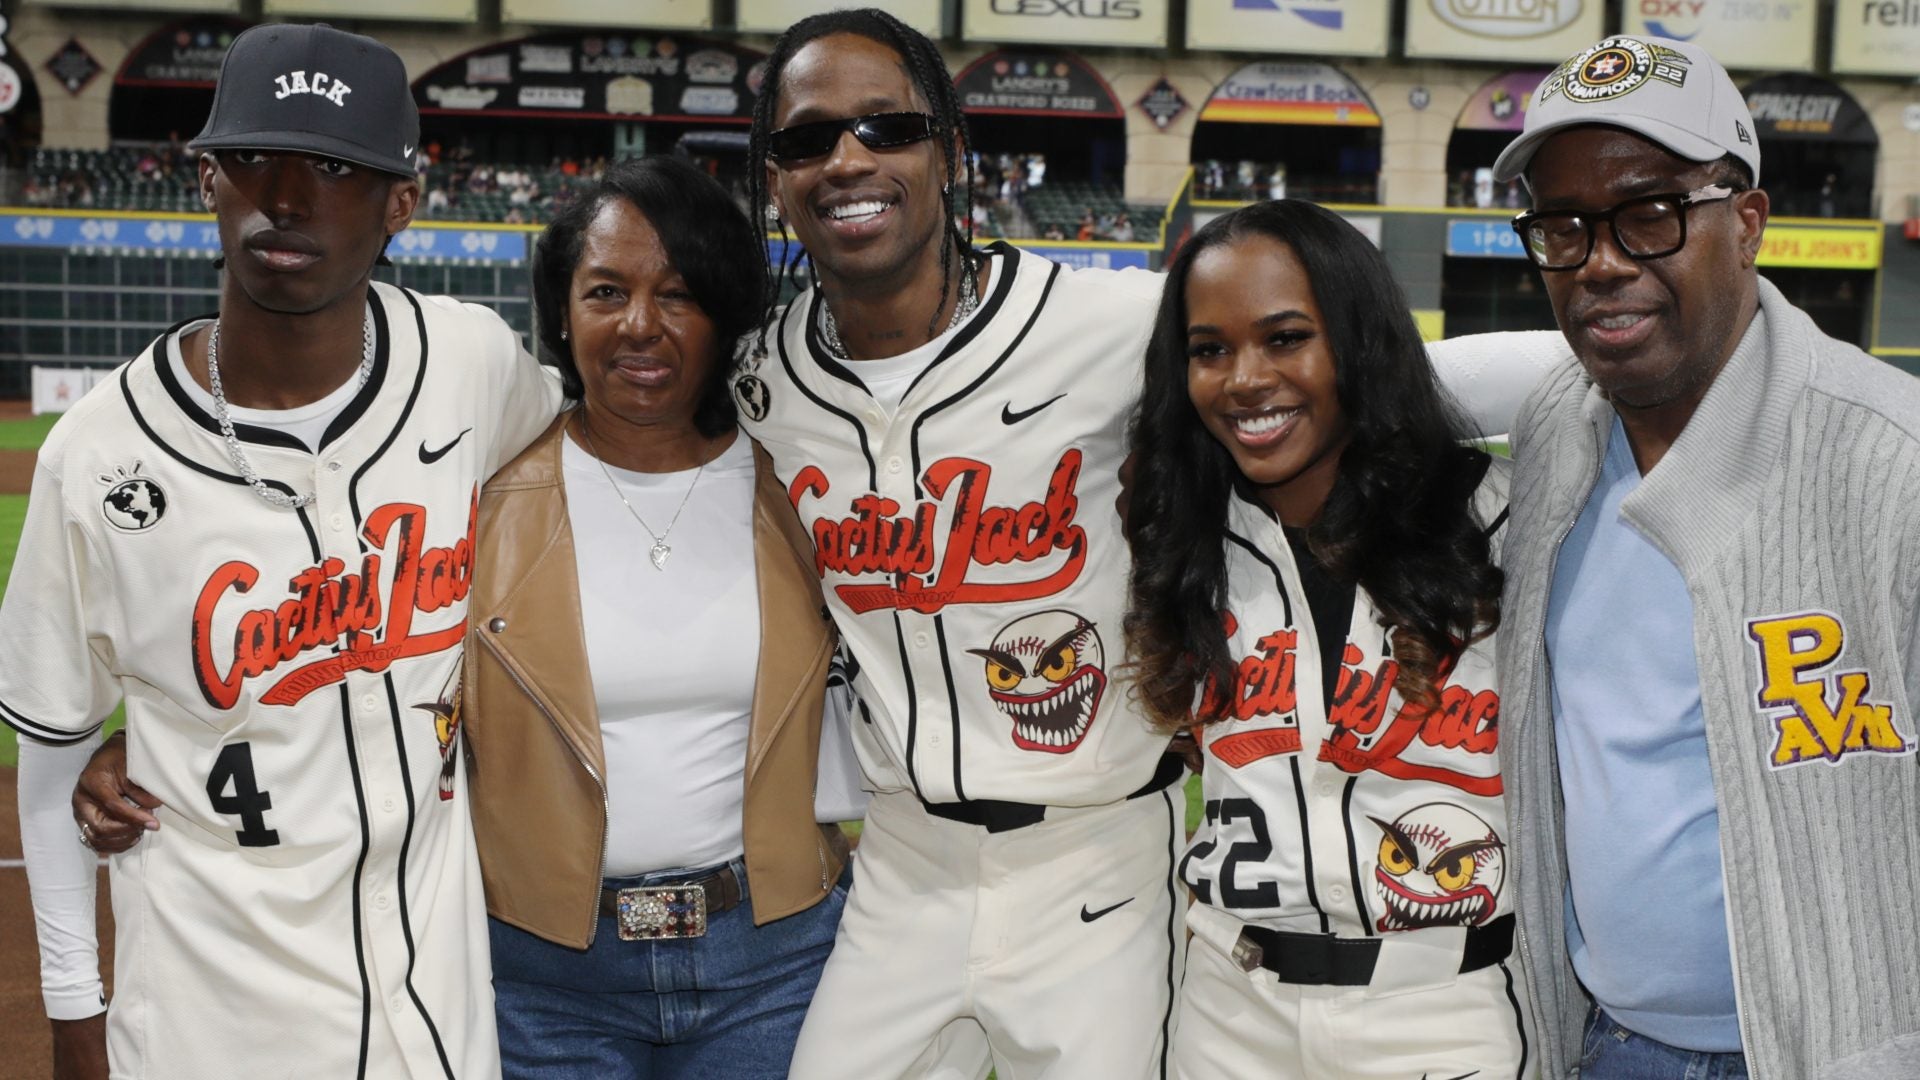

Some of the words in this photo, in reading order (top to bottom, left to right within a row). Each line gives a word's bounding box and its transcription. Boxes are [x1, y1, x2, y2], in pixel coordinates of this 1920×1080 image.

[990, 0, 1141, 19] LEXUS
[1639, 0, 1704, 16] OXY
[1567, 39, 1615, 75] WORLD
[1616, 39, 1650, 66] SERIES
[274, 70, 352, 107] JACK
[1226, 81, 1309, 101] Crawford
[1315, 84, 1357, 102] Bock
[1542, 78, 1564, 100] 20
[1655, 64, 1683, 82] 22
[1567, 73, 1642, 99] CHAMPIONS
[897, 448, 1088, 614] Jack
[191, 557, 382, 710] Cactus
[272, 644, 402, 704] FOUNDATION
[205, 741, 281, 848] 4
